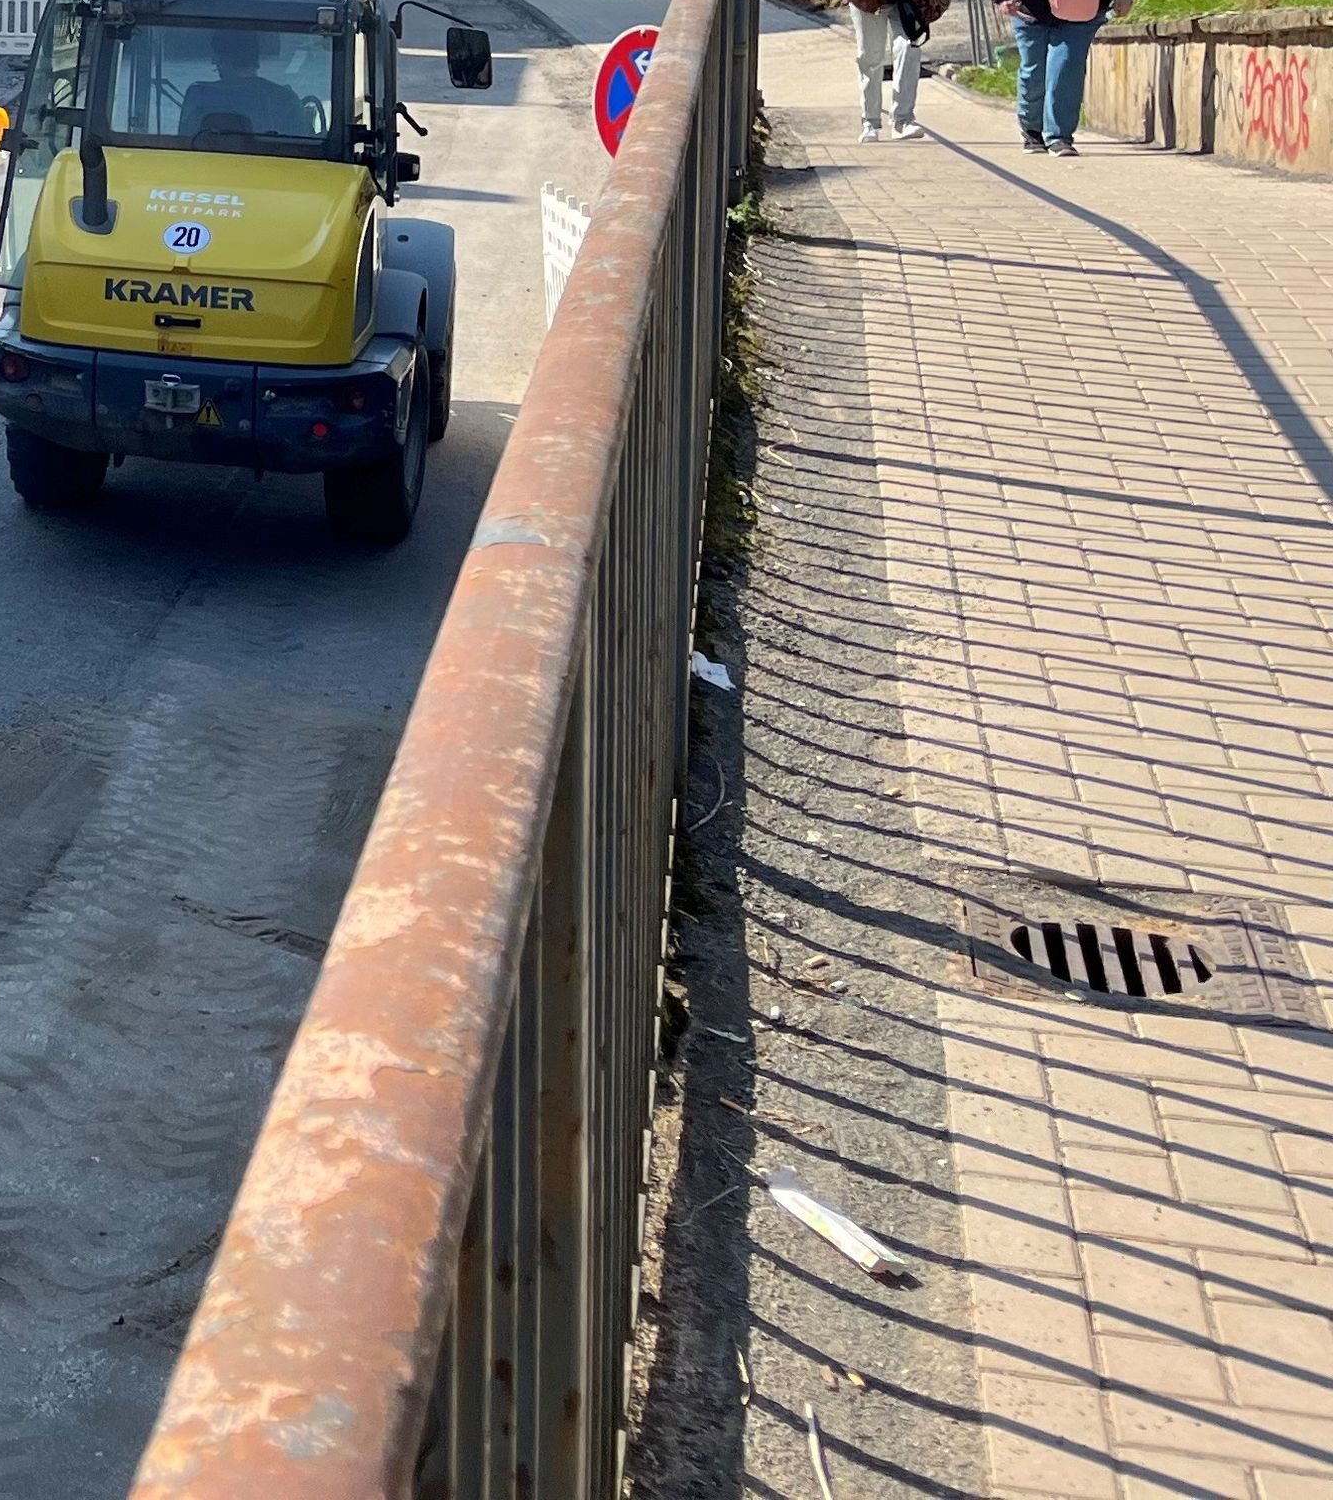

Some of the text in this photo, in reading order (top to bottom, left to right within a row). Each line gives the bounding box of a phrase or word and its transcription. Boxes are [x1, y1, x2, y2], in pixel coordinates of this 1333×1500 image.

[149, 188, 245, 206] KIESEL
[146, 203, 244, 218] MIETPARK
[172, 226, 201, 248] 20
[105, 278, 255, 312] KRAMER
